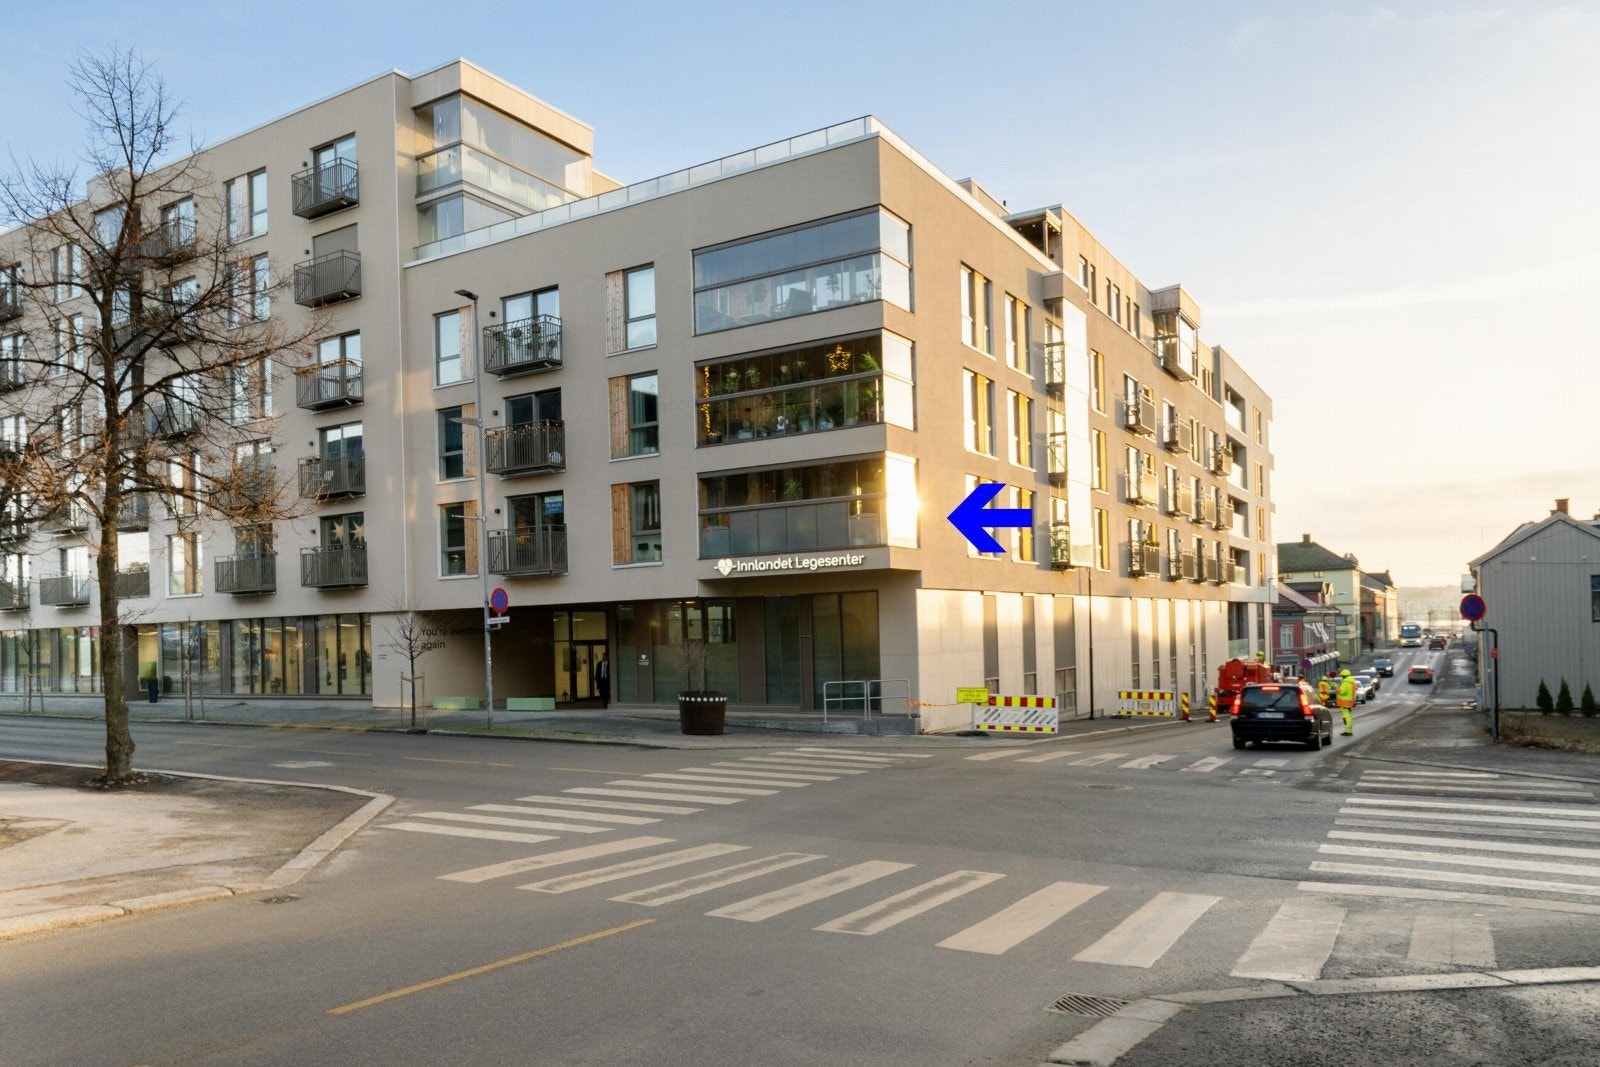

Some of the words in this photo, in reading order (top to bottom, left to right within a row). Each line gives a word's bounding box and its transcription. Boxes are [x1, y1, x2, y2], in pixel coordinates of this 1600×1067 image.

[737, 558, 793, 572] Innlandet
[795, 554, 865, 571] Legesenter
[421, 627, 447, 636] You're
[421, 641, 446, 651] again
